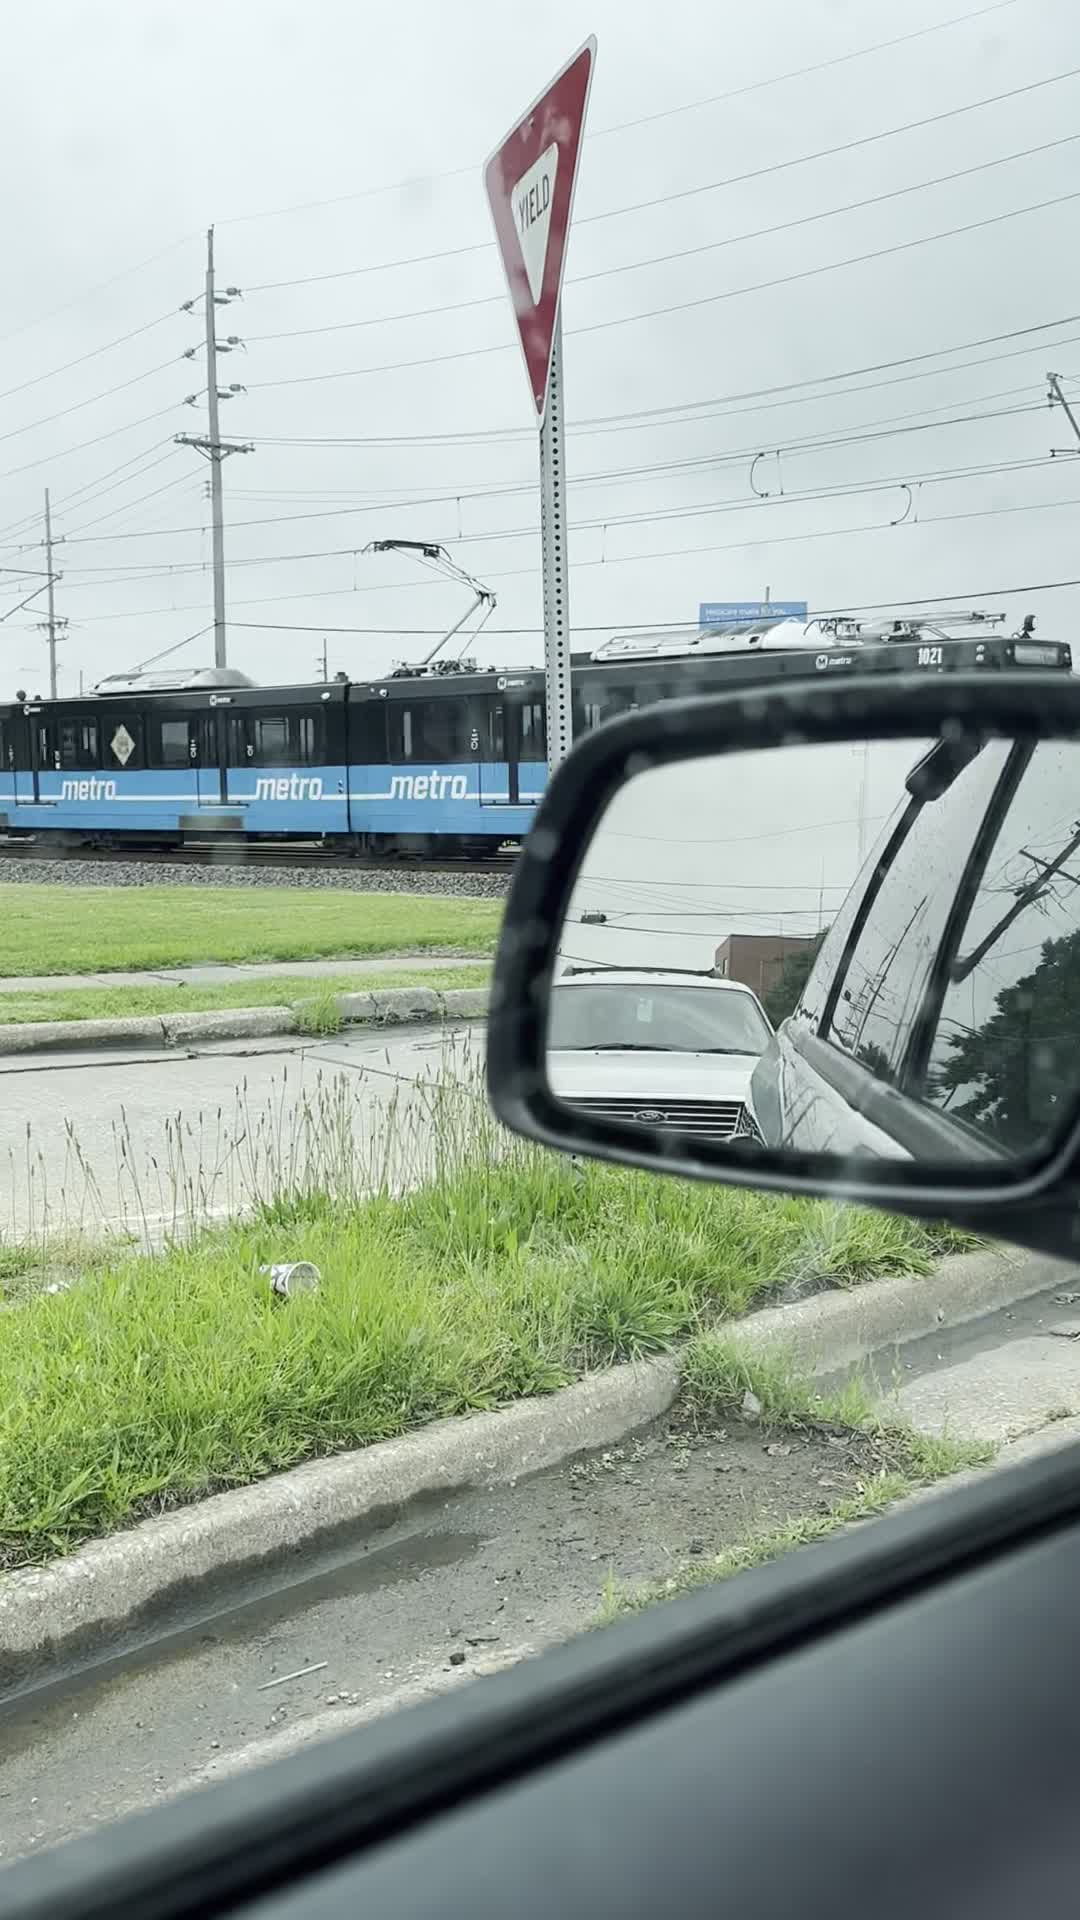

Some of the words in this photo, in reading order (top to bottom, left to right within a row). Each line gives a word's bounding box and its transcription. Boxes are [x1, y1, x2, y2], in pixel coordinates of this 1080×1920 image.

[519, 173, 550, 233] YIELD
[918, 647, 943, 665] 1021
[62, 775, 117, 801] metro
[256, 772, 323, 801] metro
[390, 769, 468, 801] metro
